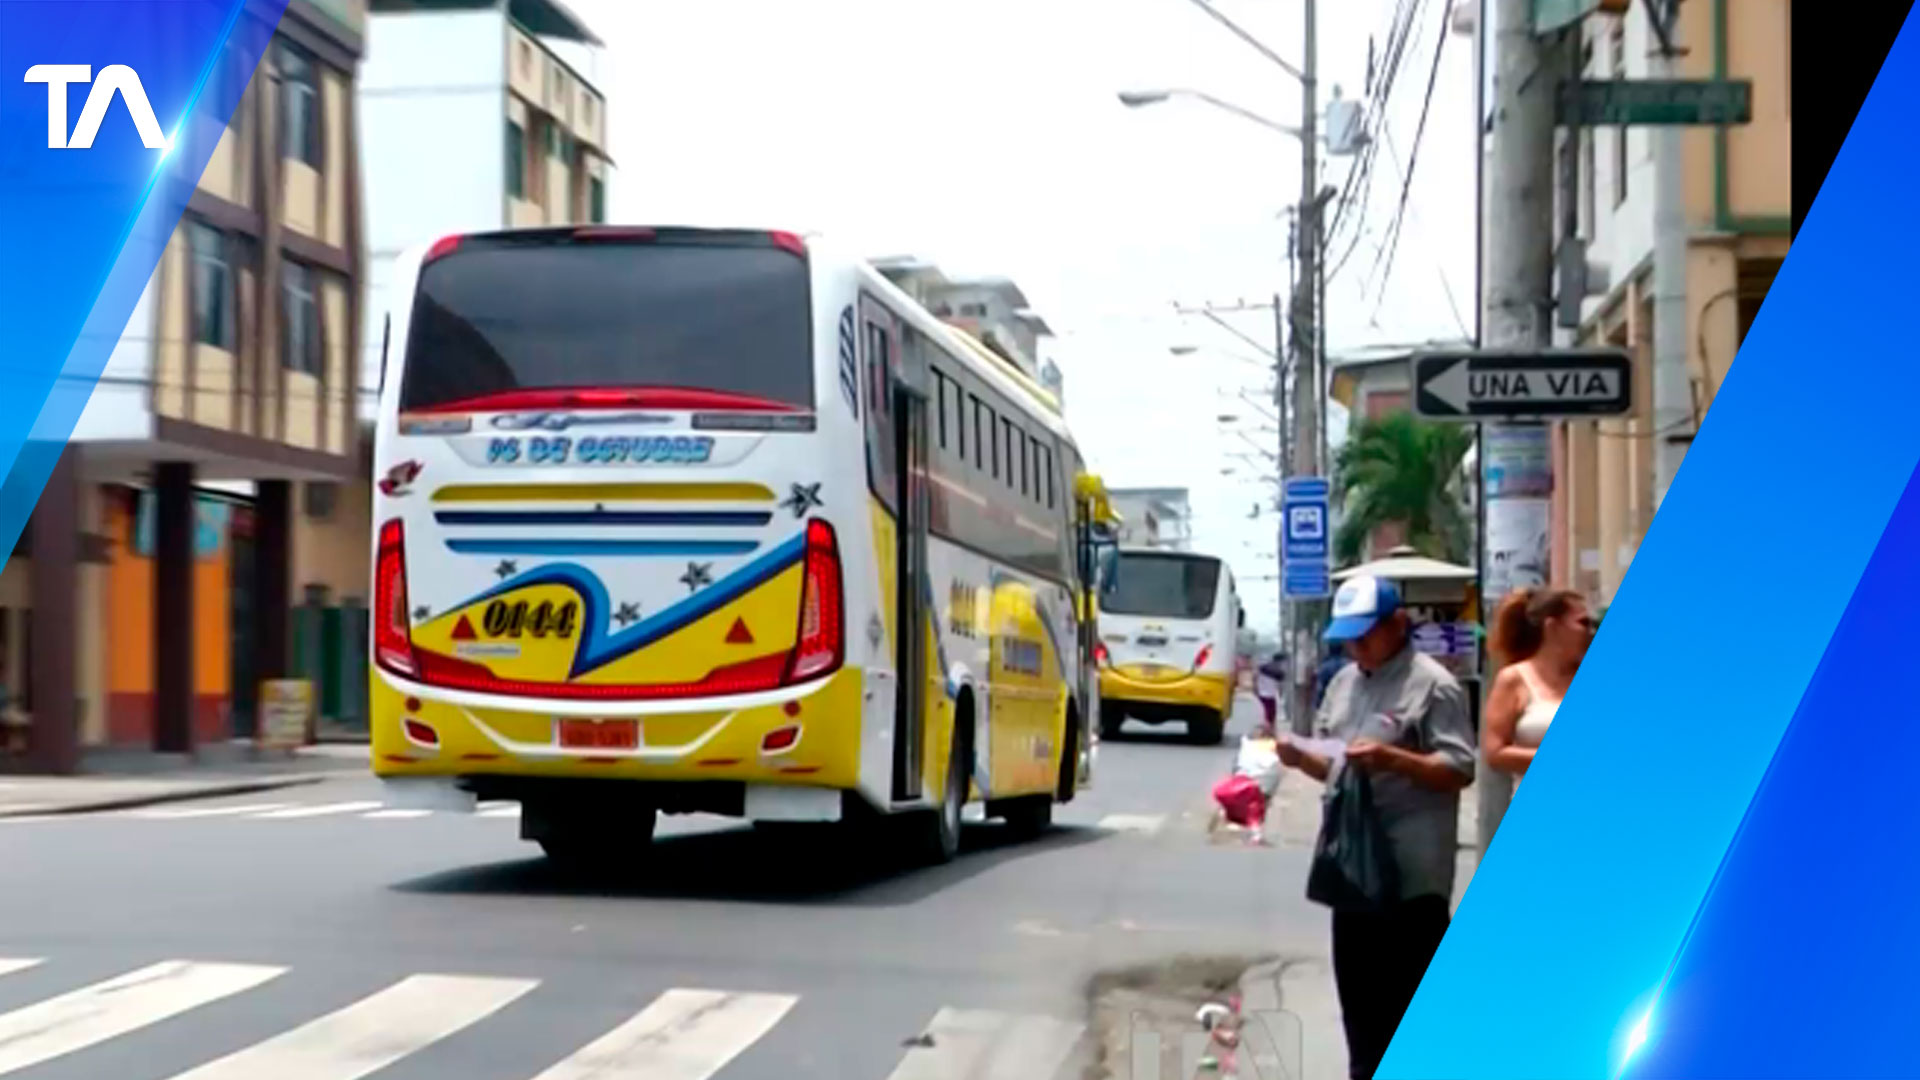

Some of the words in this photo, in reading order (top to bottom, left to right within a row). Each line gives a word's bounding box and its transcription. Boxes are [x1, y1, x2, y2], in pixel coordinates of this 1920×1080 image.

[1468, 373, 1530, 396] UNA
[1546, 373, 1609, 396] VIA
[529, 436, 572, 463] DE
[483, 600, 577, 638] 0144
